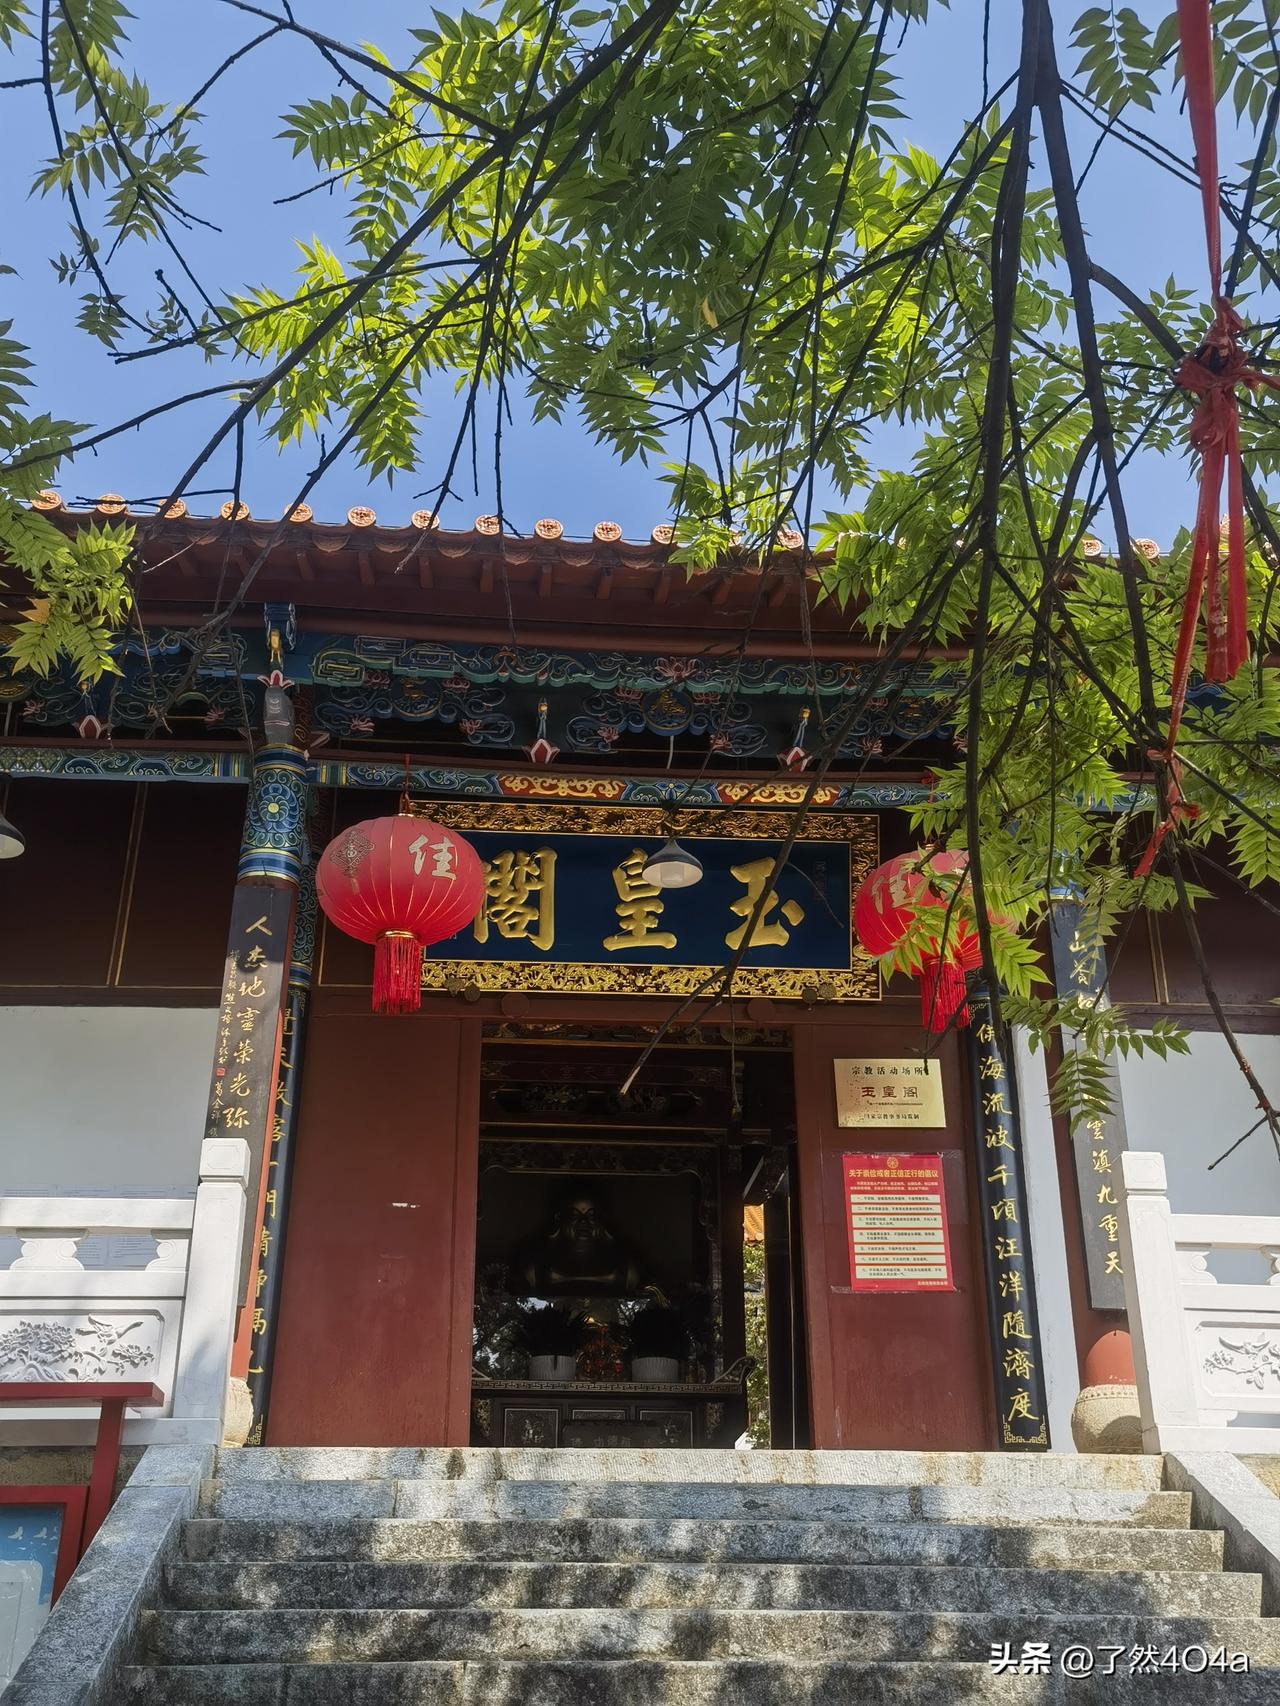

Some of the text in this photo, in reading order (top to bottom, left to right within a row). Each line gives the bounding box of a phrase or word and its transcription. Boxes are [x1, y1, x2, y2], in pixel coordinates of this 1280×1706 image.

[408, 834, 457, 880] 佳
[852, 1065, 924, 1076] 宗教活动场所
[861, 1085, 918, 1098] 玉皇阁
